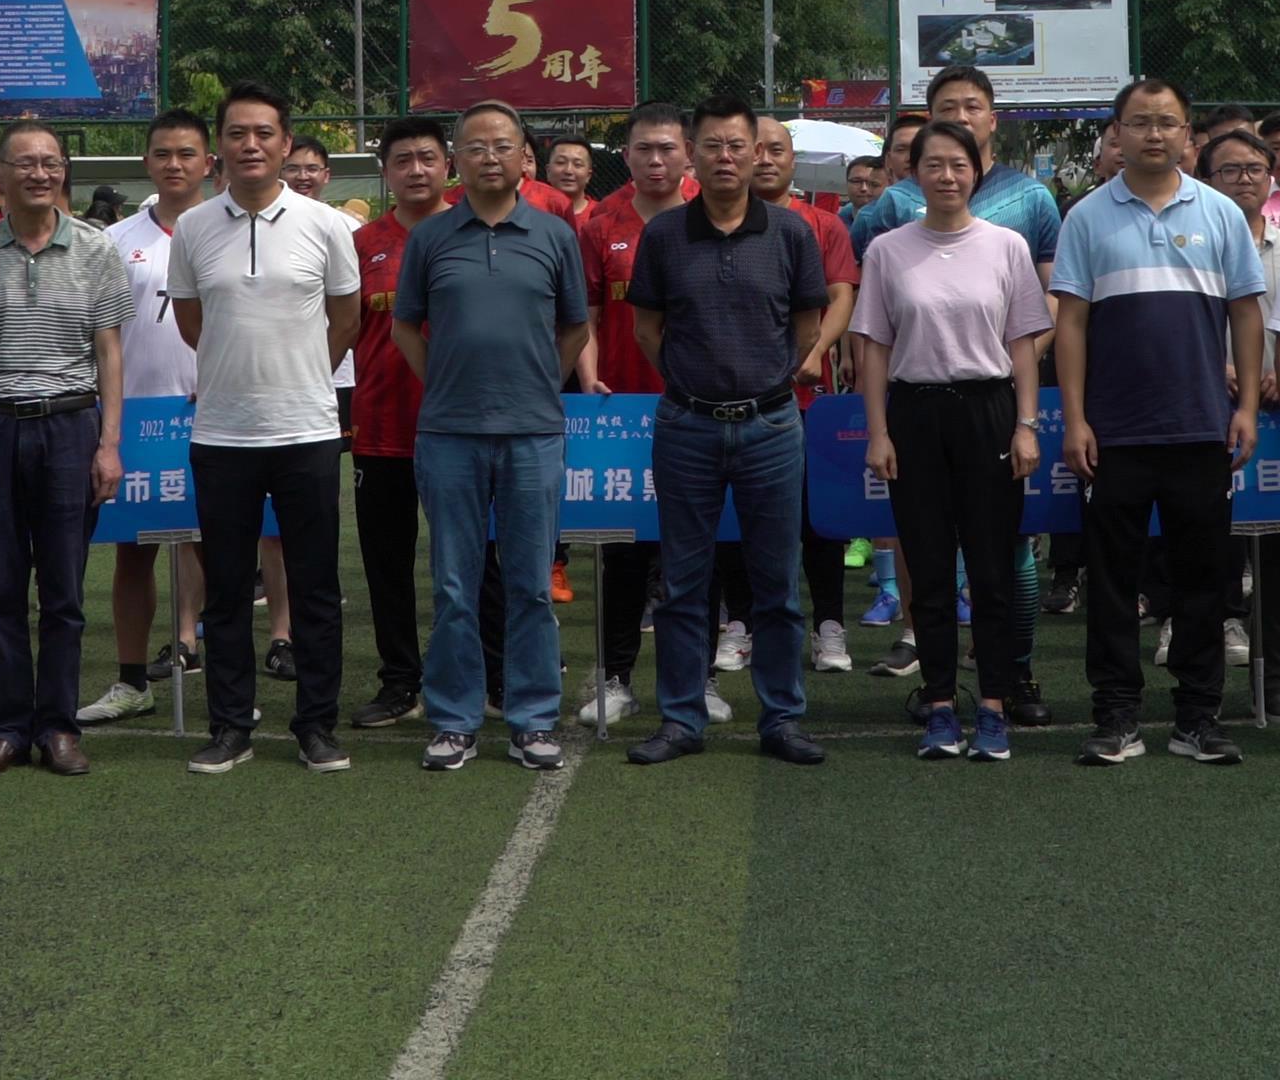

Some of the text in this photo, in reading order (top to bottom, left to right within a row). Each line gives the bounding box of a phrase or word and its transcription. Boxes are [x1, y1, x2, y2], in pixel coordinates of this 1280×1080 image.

[541, 44, 612, 89] 周年
[139, 419, 164, 437] 2022
[564, 417, 590, 434] 2022
[104, 468, 186, 504] 市委
